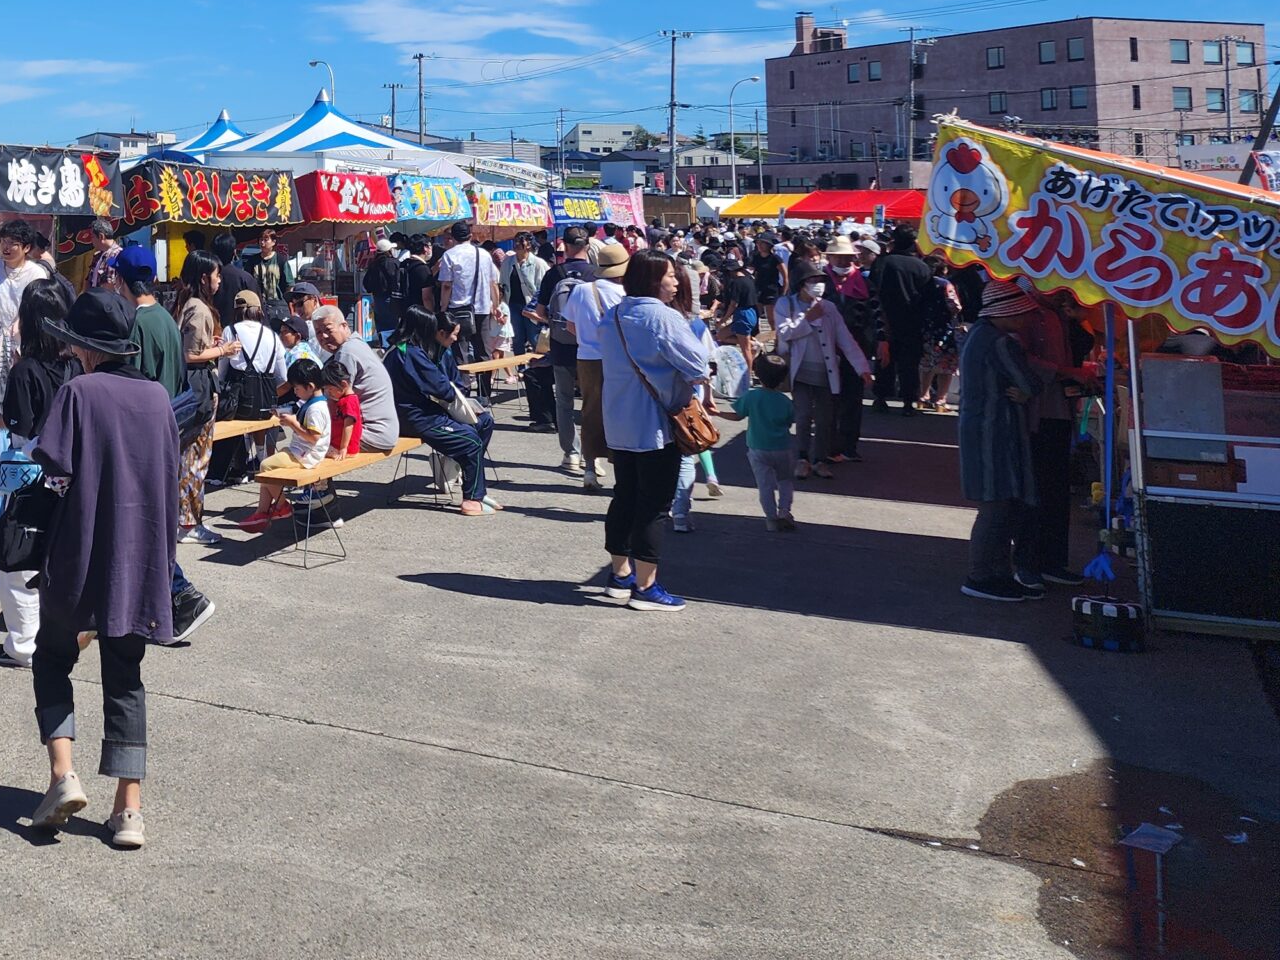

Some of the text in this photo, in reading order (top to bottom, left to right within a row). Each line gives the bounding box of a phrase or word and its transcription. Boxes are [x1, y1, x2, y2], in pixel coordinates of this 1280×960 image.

[7, 157, 84, 208] 焼き鳥
[183, 169, 271, 222] はしまき
[1044, 166, 1280, 256] あげたて!アツ
[1006, 198, 1280, 341] からあ
